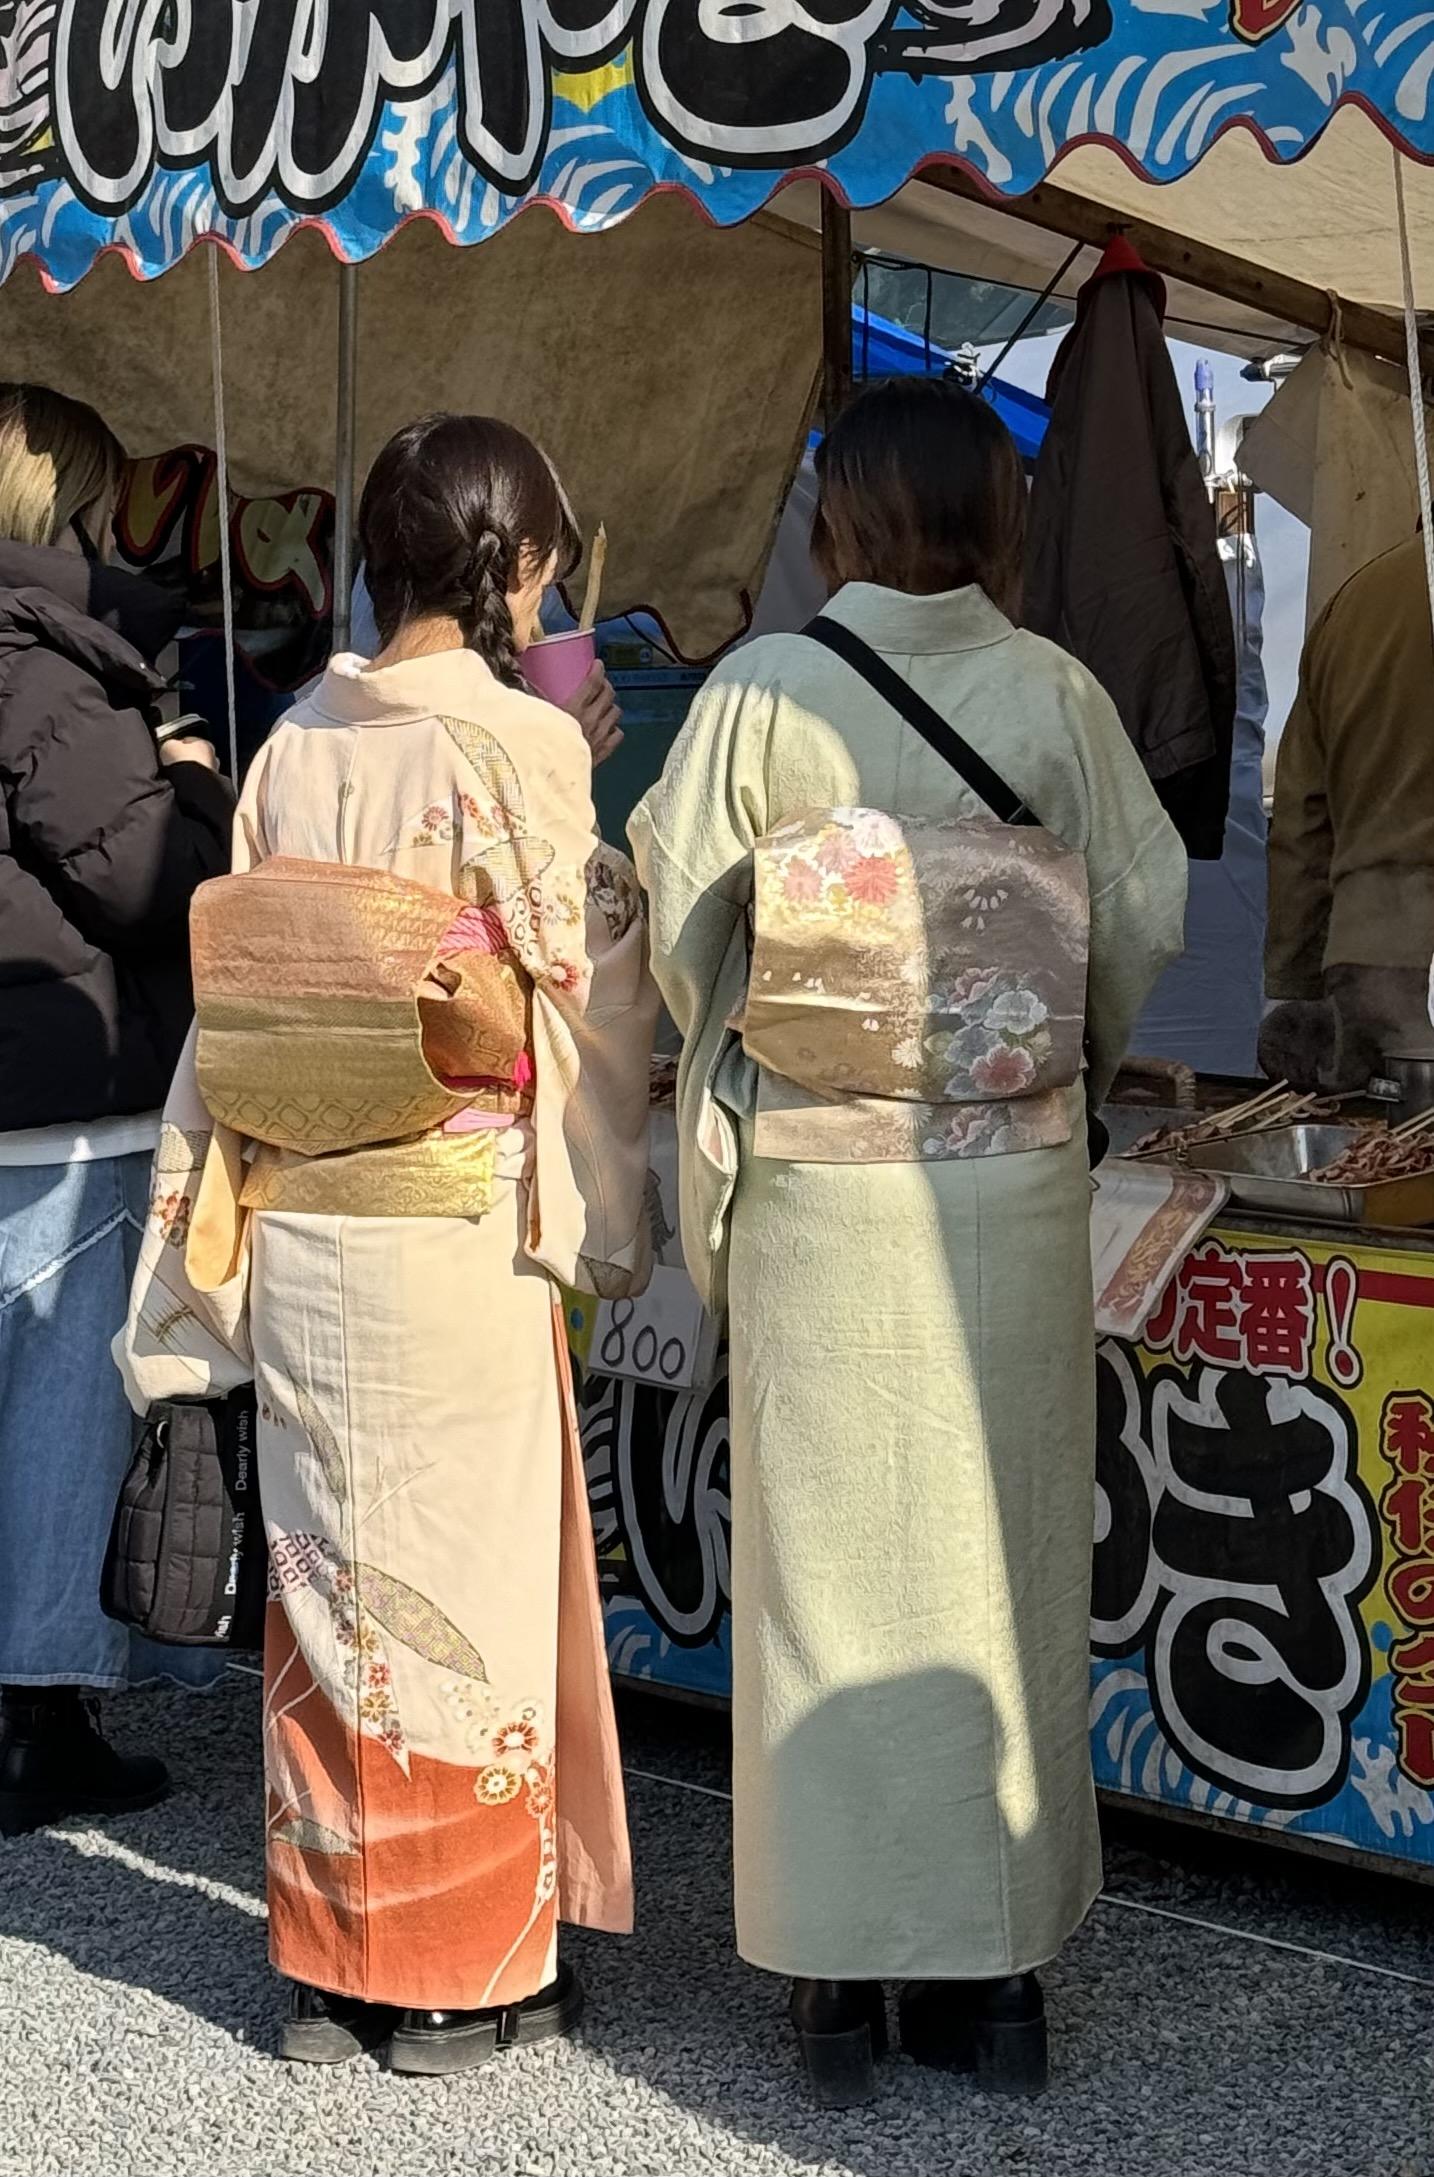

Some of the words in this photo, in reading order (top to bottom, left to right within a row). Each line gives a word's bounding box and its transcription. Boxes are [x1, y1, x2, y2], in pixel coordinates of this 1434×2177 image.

[600, 1296, 686, 1379] 800
[236, 1409, 249, 1441] wish
[234, 1445, 252, 1491] Dearly
